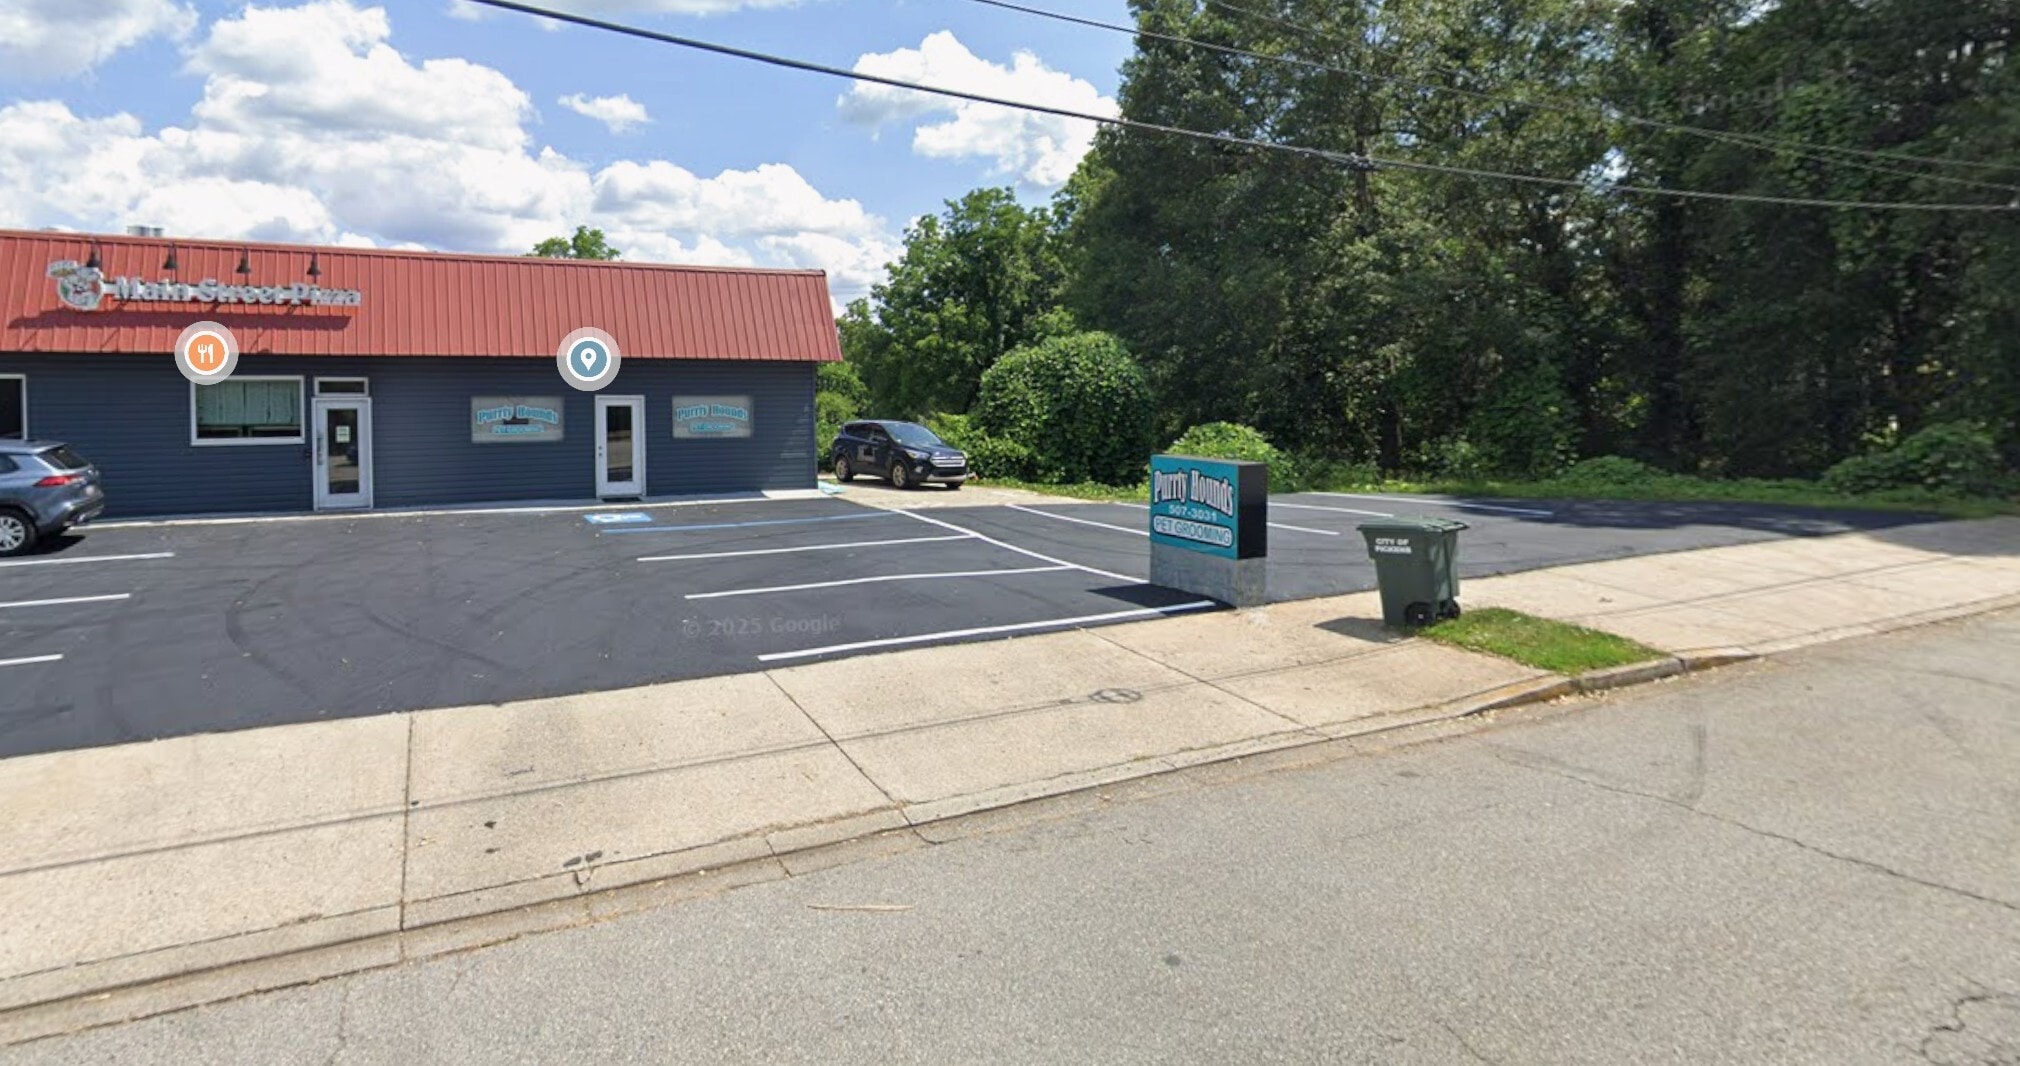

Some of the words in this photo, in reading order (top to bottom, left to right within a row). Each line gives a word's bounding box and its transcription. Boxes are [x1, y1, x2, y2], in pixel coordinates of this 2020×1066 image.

[115, 275, 190, 301] Main
[197, 277, 288, 304] Street
[290, 282, 361, 306] Pizza
[516, 405, 559, 424] Hounds
[711, 404, 748, 421] Hounds
[1154, 469, 1188, 503] Purrty
[1190, 469, 1233, 516] Hounds
[1155, 518, 1173, 532] PET
[1175, 521, 1231, 544] GROOMING
[1375, 537, 1395, 546] CITY
[1396, 538, 1410, 546] OF
